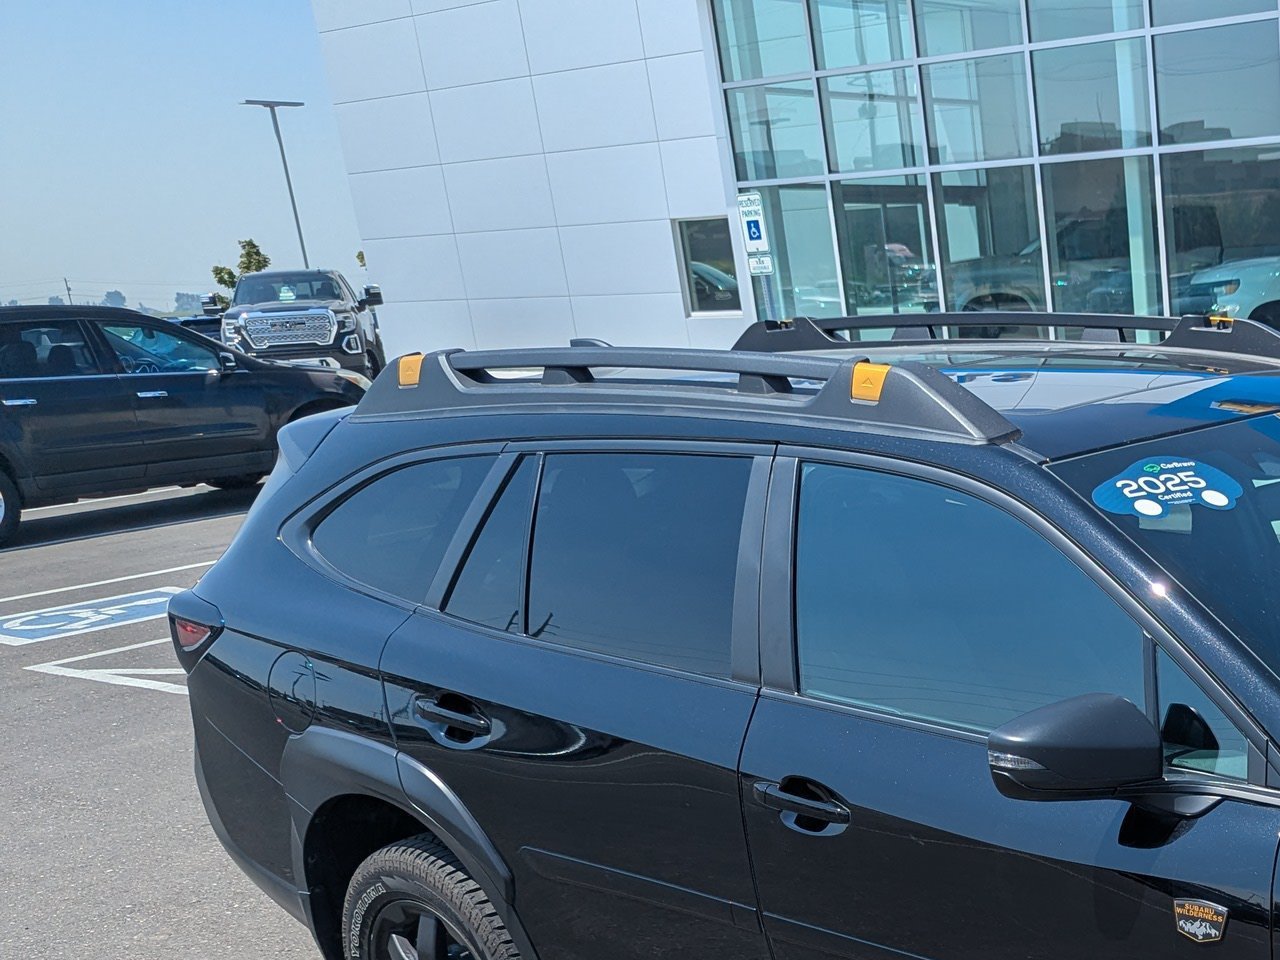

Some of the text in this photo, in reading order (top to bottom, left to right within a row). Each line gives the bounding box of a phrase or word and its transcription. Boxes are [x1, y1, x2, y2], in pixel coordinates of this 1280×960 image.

[1160, 461, 1196, 469] CarBravo
[1116, 471, 1207, 498] 2025
[1158, 491, 1193, 501] Certified
[1176, 907, 1223, 922] WILDERNESS
[1184, 903, 1215, 914] SUBARU
[352, 883, 386, 958] YOKOHAMA
